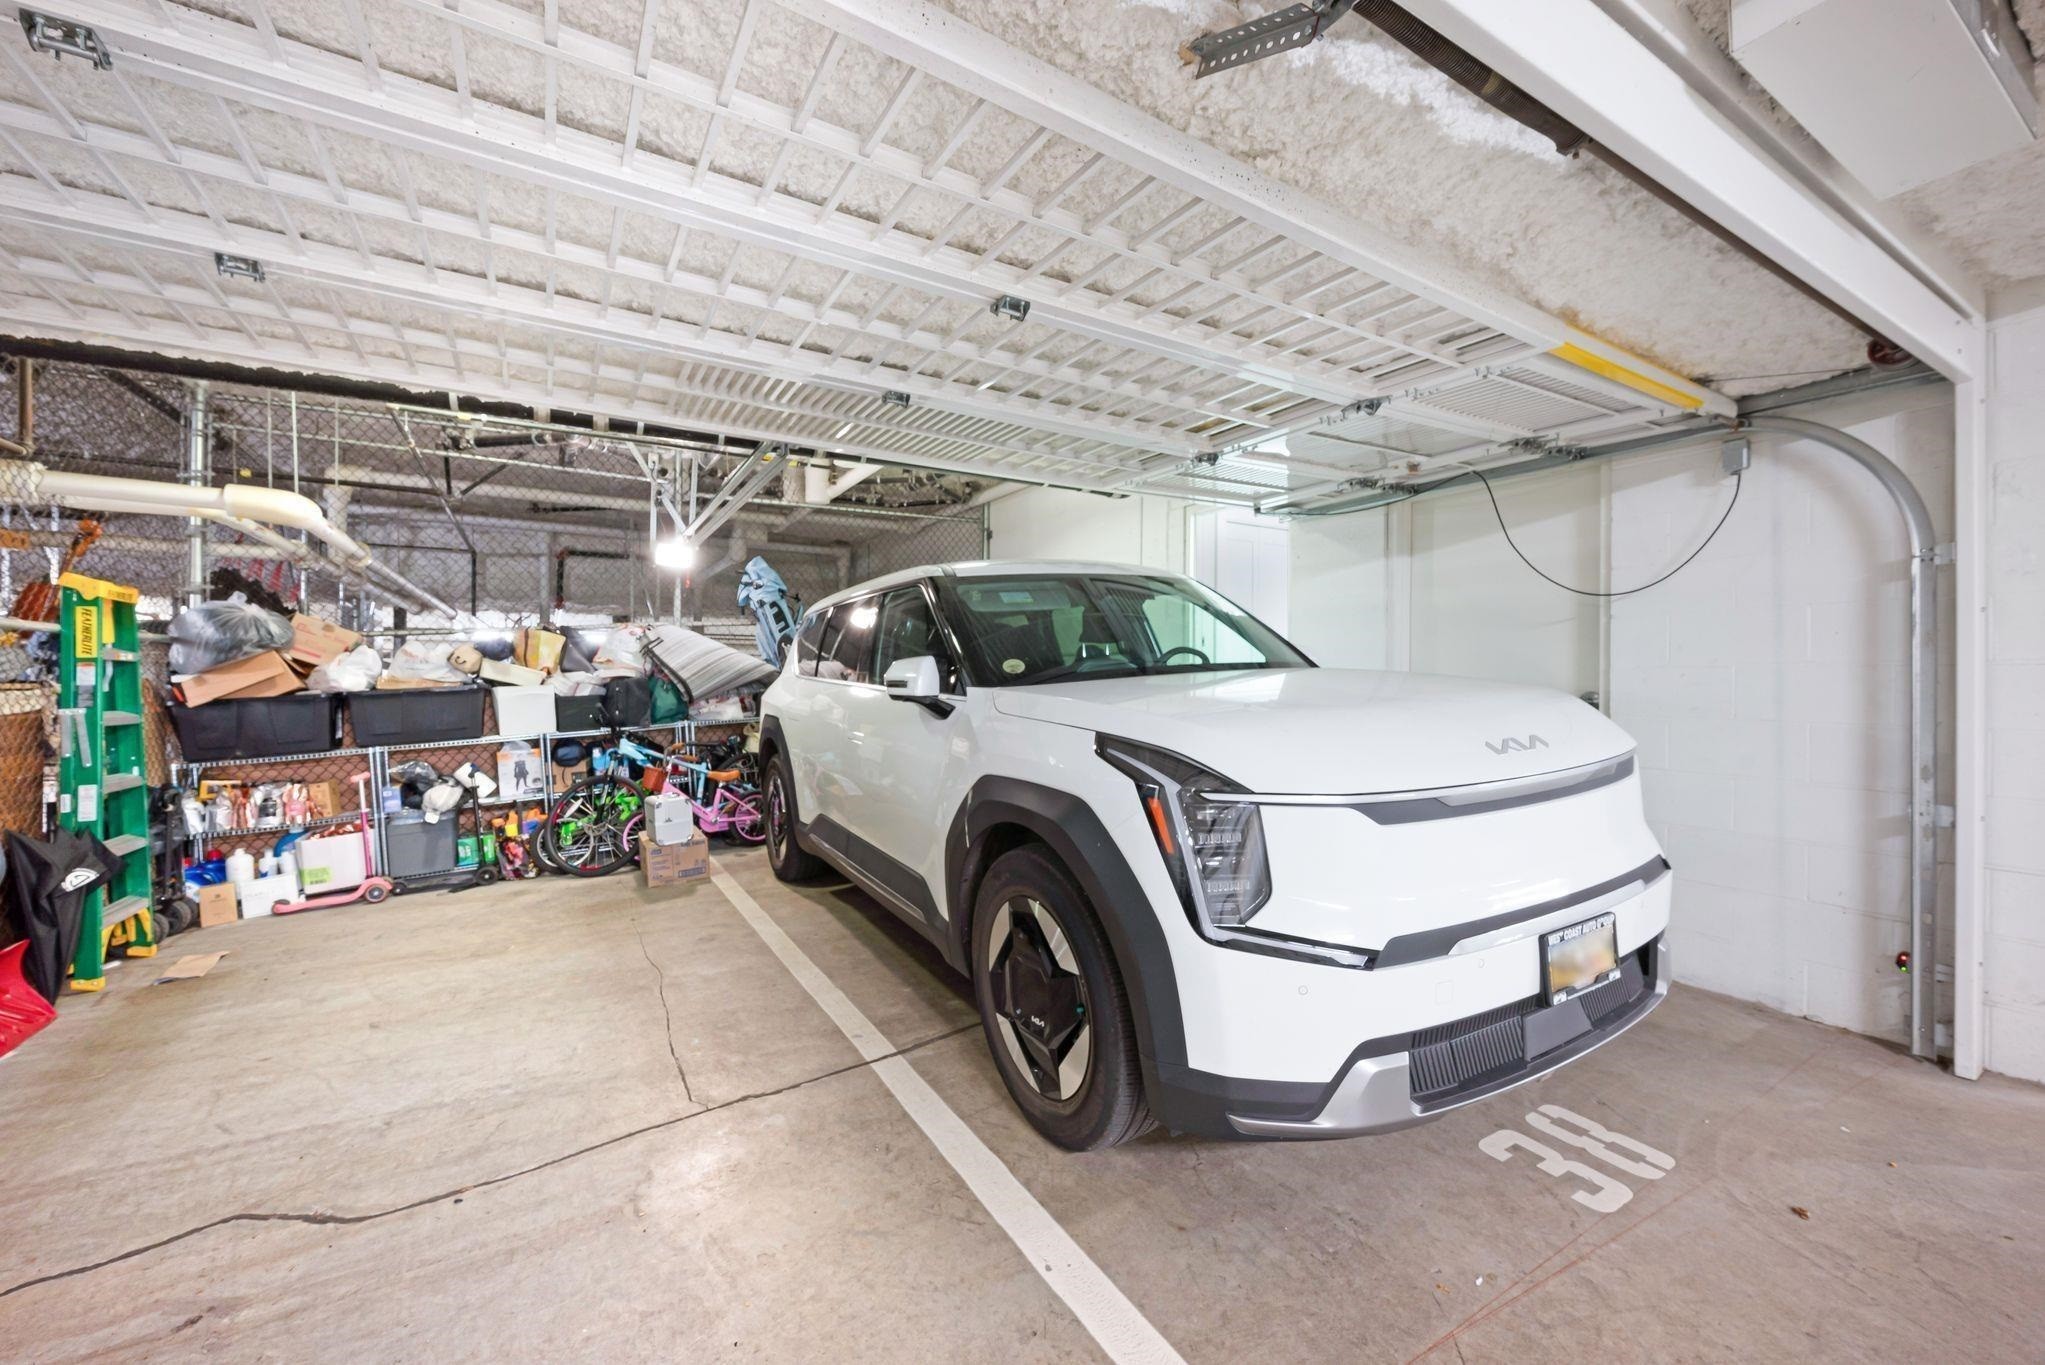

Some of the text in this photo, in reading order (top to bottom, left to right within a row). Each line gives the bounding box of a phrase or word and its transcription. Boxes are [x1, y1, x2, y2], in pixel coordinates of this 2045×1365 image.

[81, 608, 93, 656] FEATHERLITE
[1564, 925, 1583, 941] COAST
[1583, 920, 1597, 934] AUTO
[1478, 1104, 1676, 1213] 38
